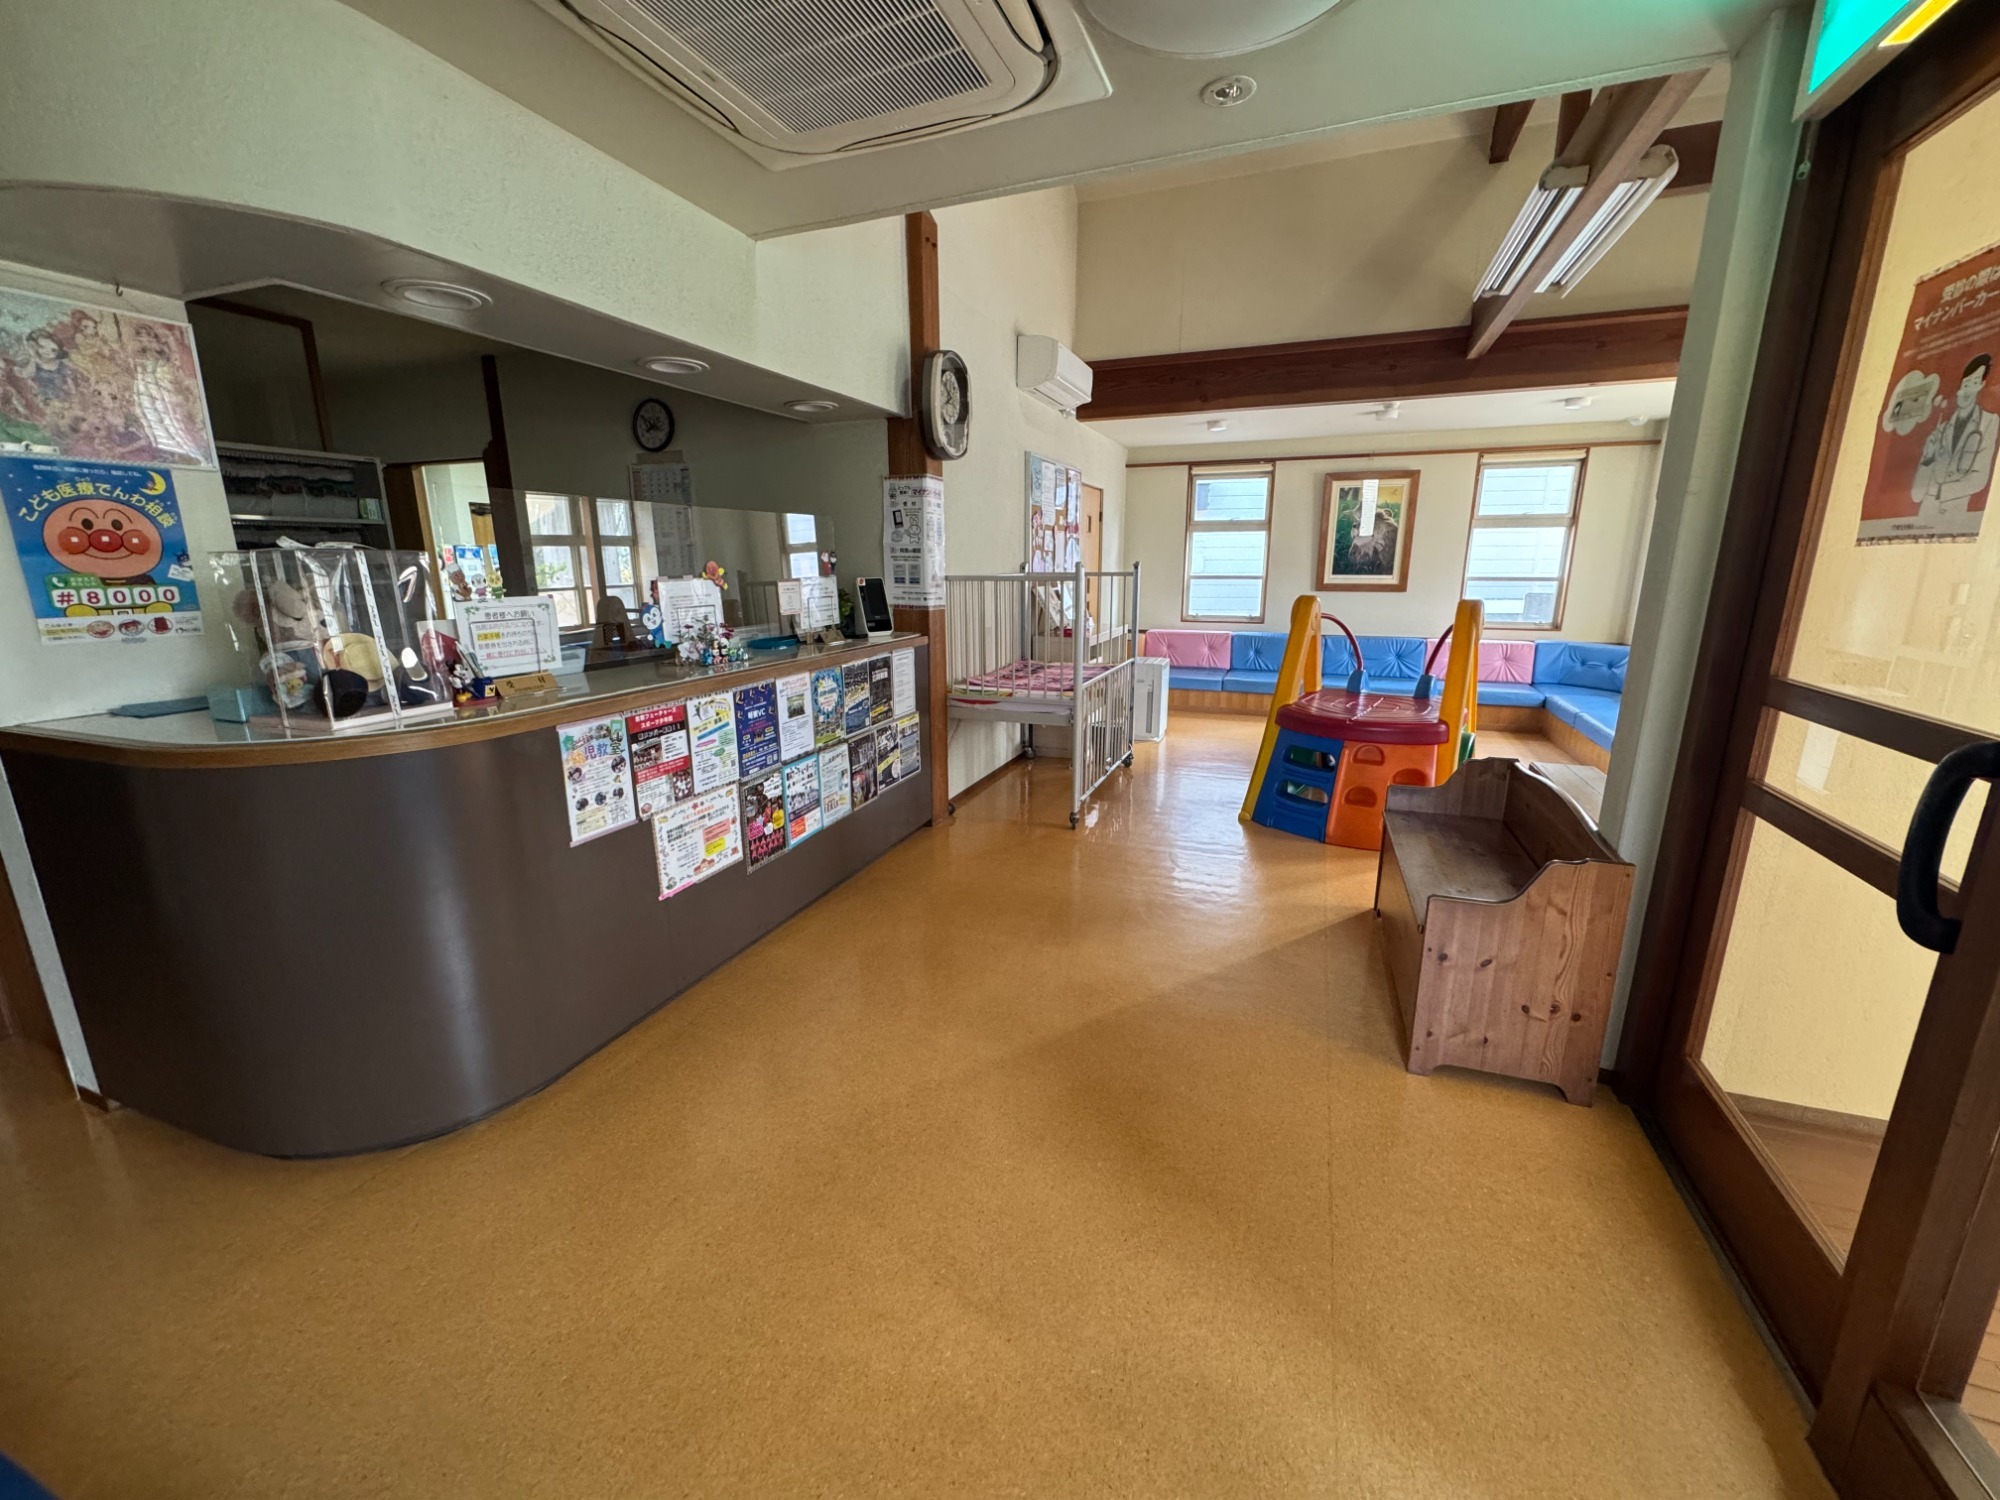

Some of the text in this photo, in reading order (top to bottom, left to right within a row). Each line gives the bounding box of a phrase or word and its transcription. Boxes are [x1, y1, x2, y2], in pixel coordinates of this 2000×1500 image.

[18, 482, 176, 528] こども医療でんわ相談
[56, 588, 176, 606] #8000
[484, 610, 535, 620] 患者様へお願い
